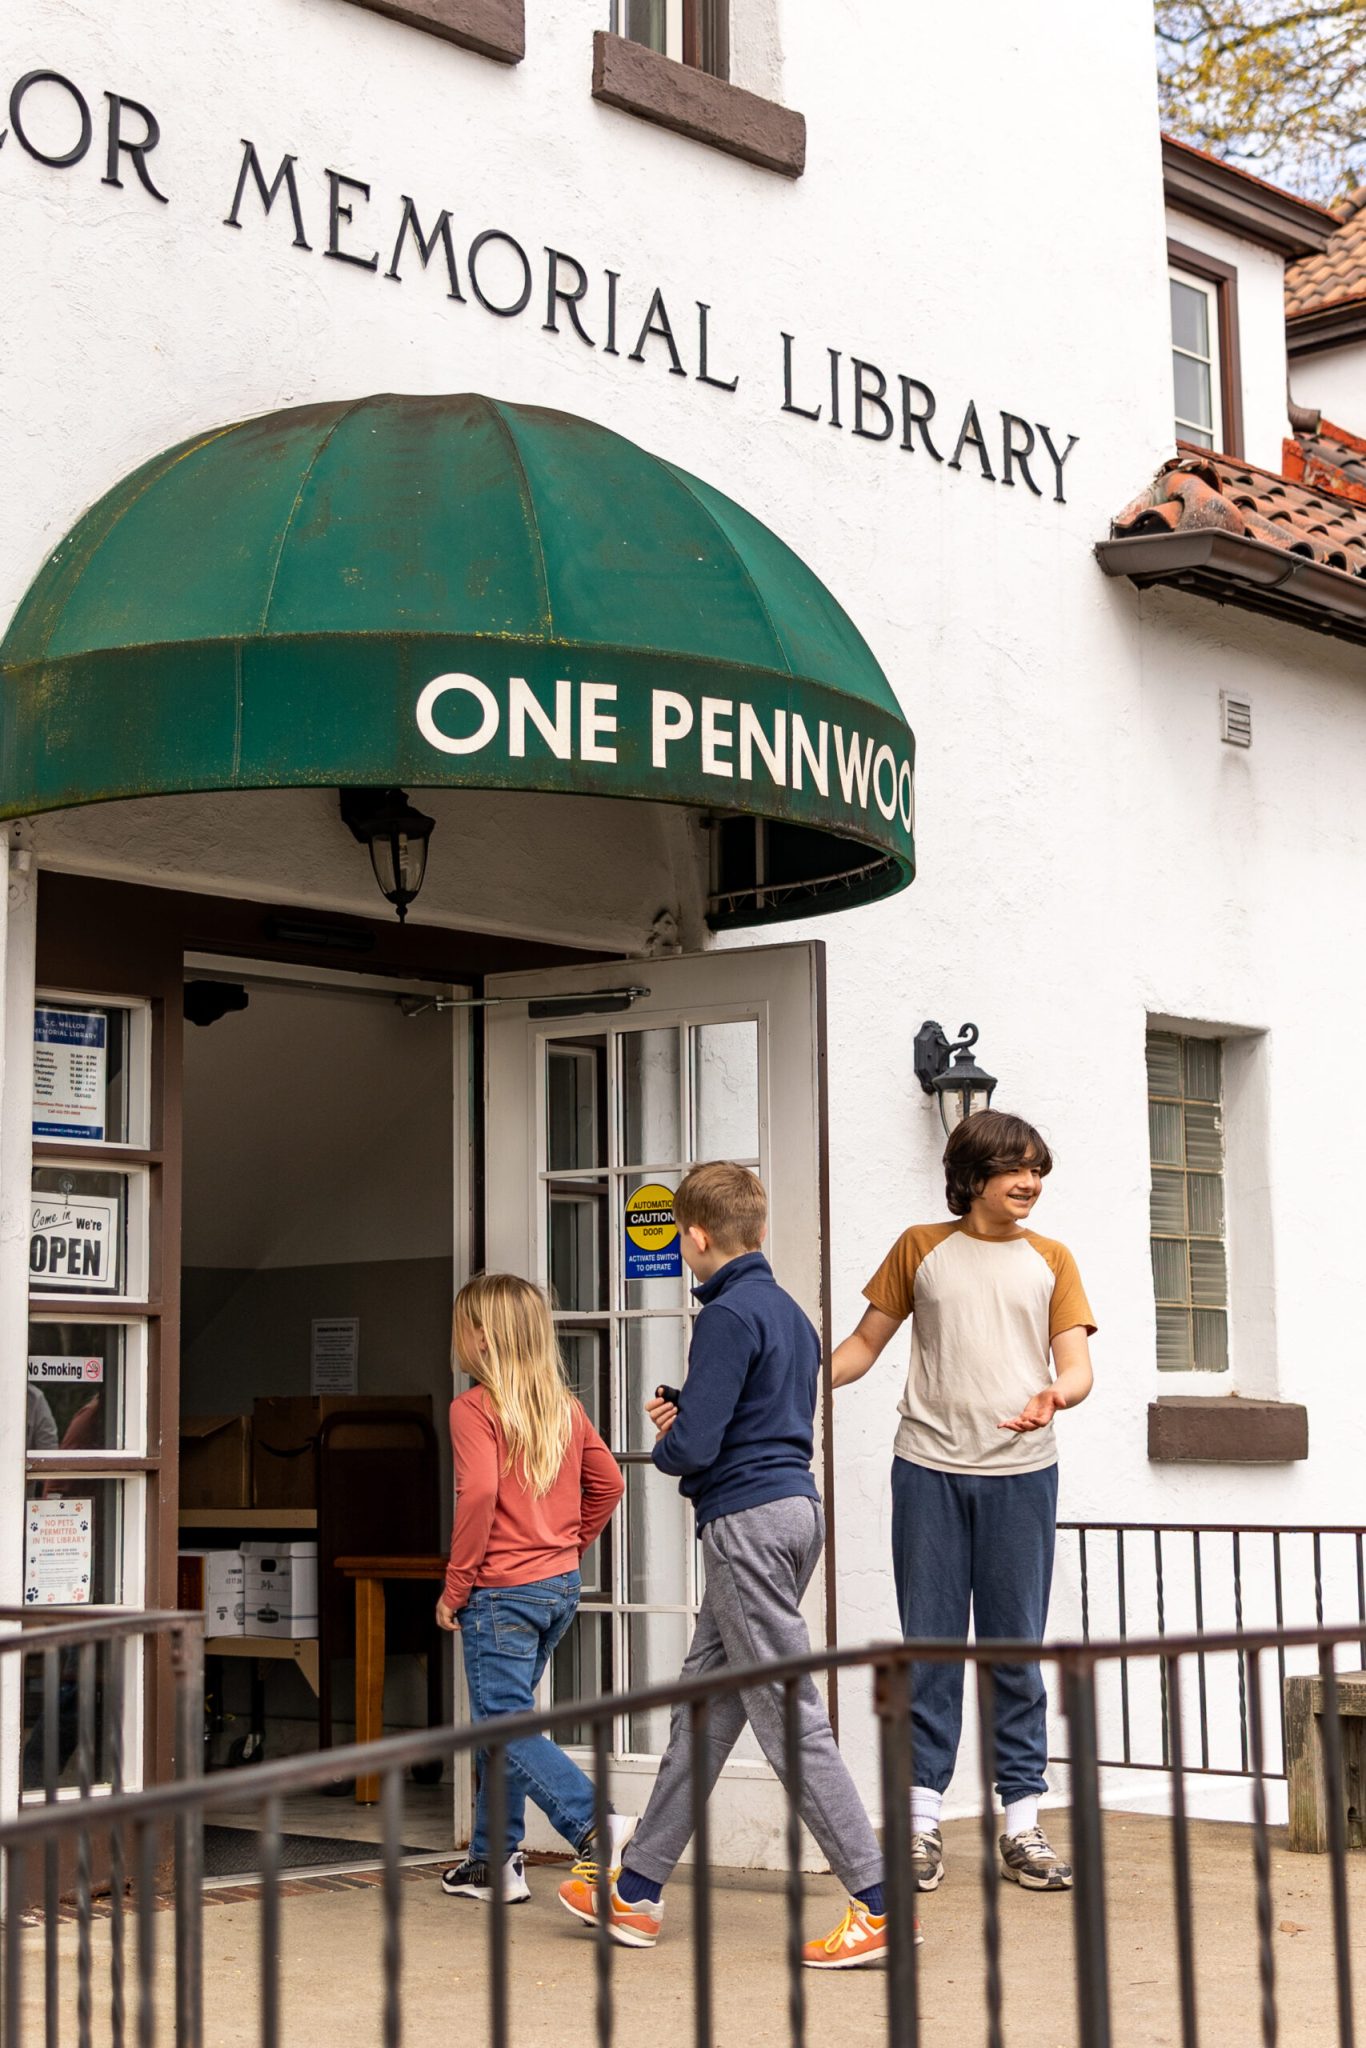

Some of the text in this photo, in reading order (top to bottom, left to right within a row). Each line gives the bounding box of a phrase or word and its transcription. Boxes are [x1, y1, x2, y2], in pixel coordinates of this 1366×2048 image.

[0, 69, 1080, 503] OR MEMORIAL LIBRARY
[415, 672, 915, 835] ONE PENNWOO
[633, 1200, 672, 1209] AUTOMATIC
[32, 1207, 71, 1229] Come in
[76, 1218, 102, 1231] We're
[631, 1212, 675, 1223] CAUTION
[643, 1228, 663, 1236] DOOR
[30, 1234, 101, 1276] OPEN
[629, 1253, 679, 1262] ACTIVATE SWITCH
[28, 1362, 82, 1379] No Smoking
[844, 1923, 868, 1949] N
